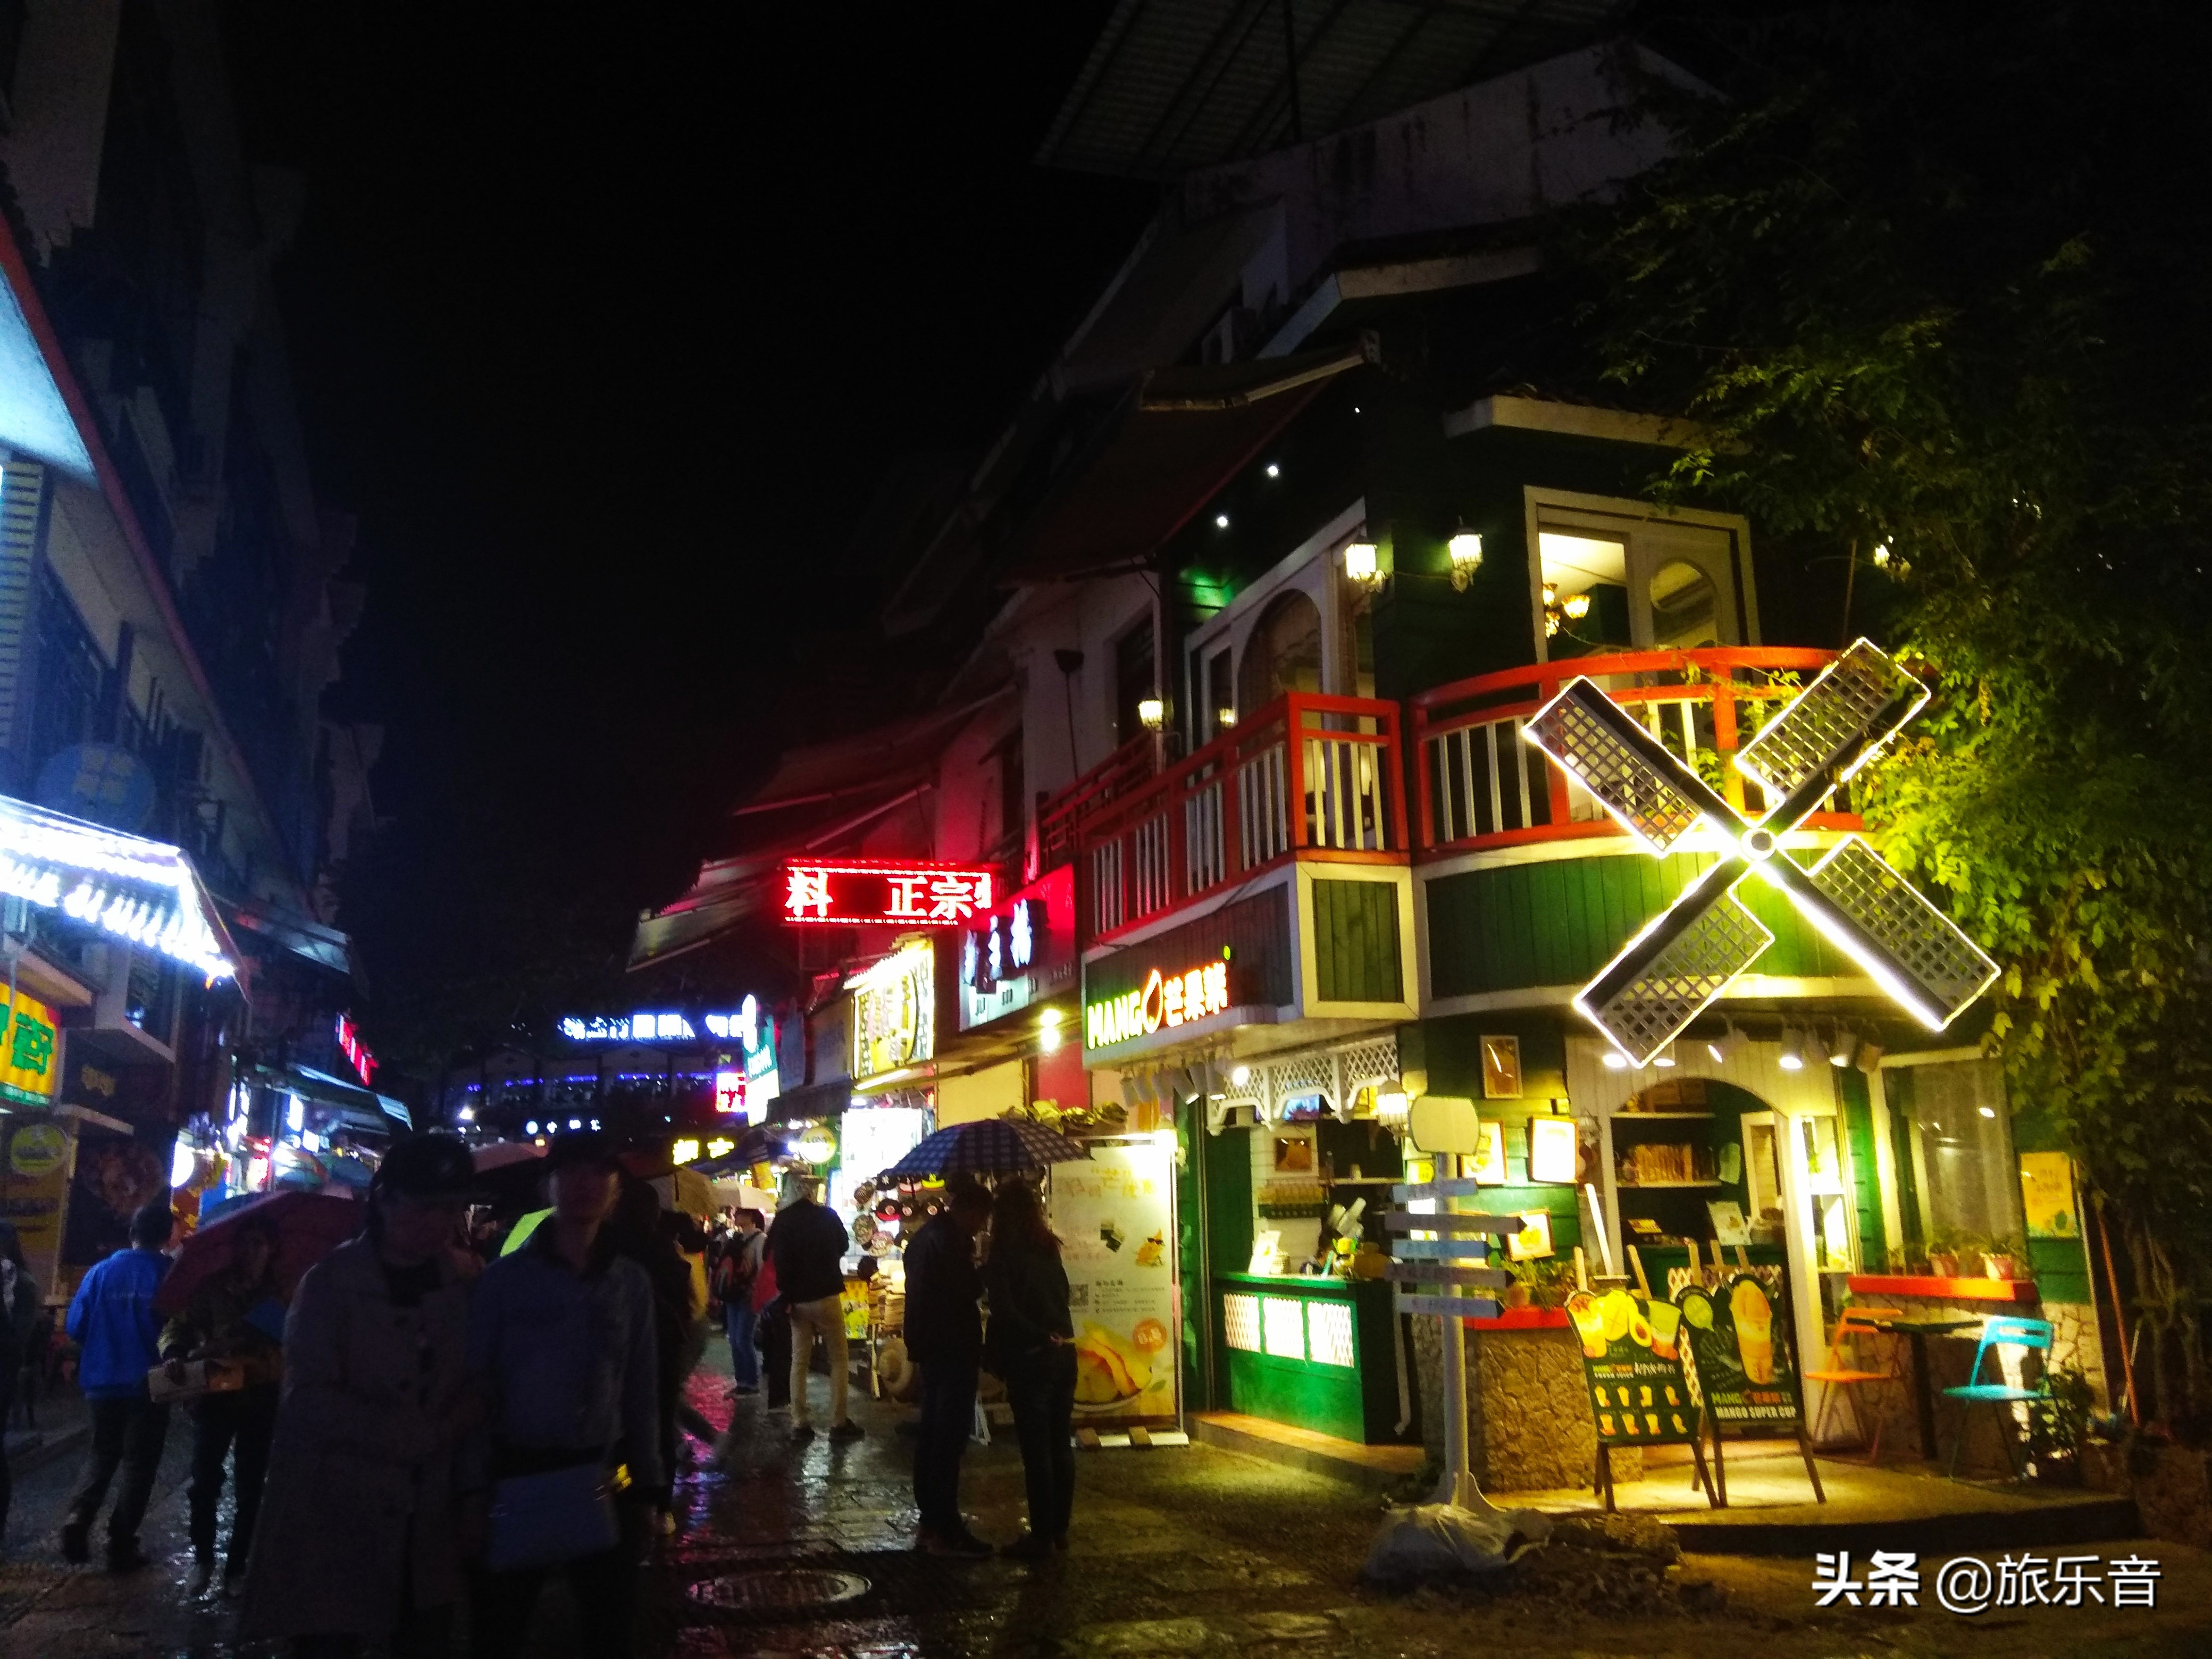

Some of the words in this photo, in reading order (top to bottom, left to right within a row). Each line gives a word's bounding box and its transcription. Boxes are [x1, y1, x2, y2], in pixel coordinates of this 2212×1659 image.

[785, 871, 834, 918] 料
[1715, 1406, 1749, 1420] MANGO
[1748, 1406, 1779, 1419] SUPER
[1778, 1405, 1797, 1418] CUP
